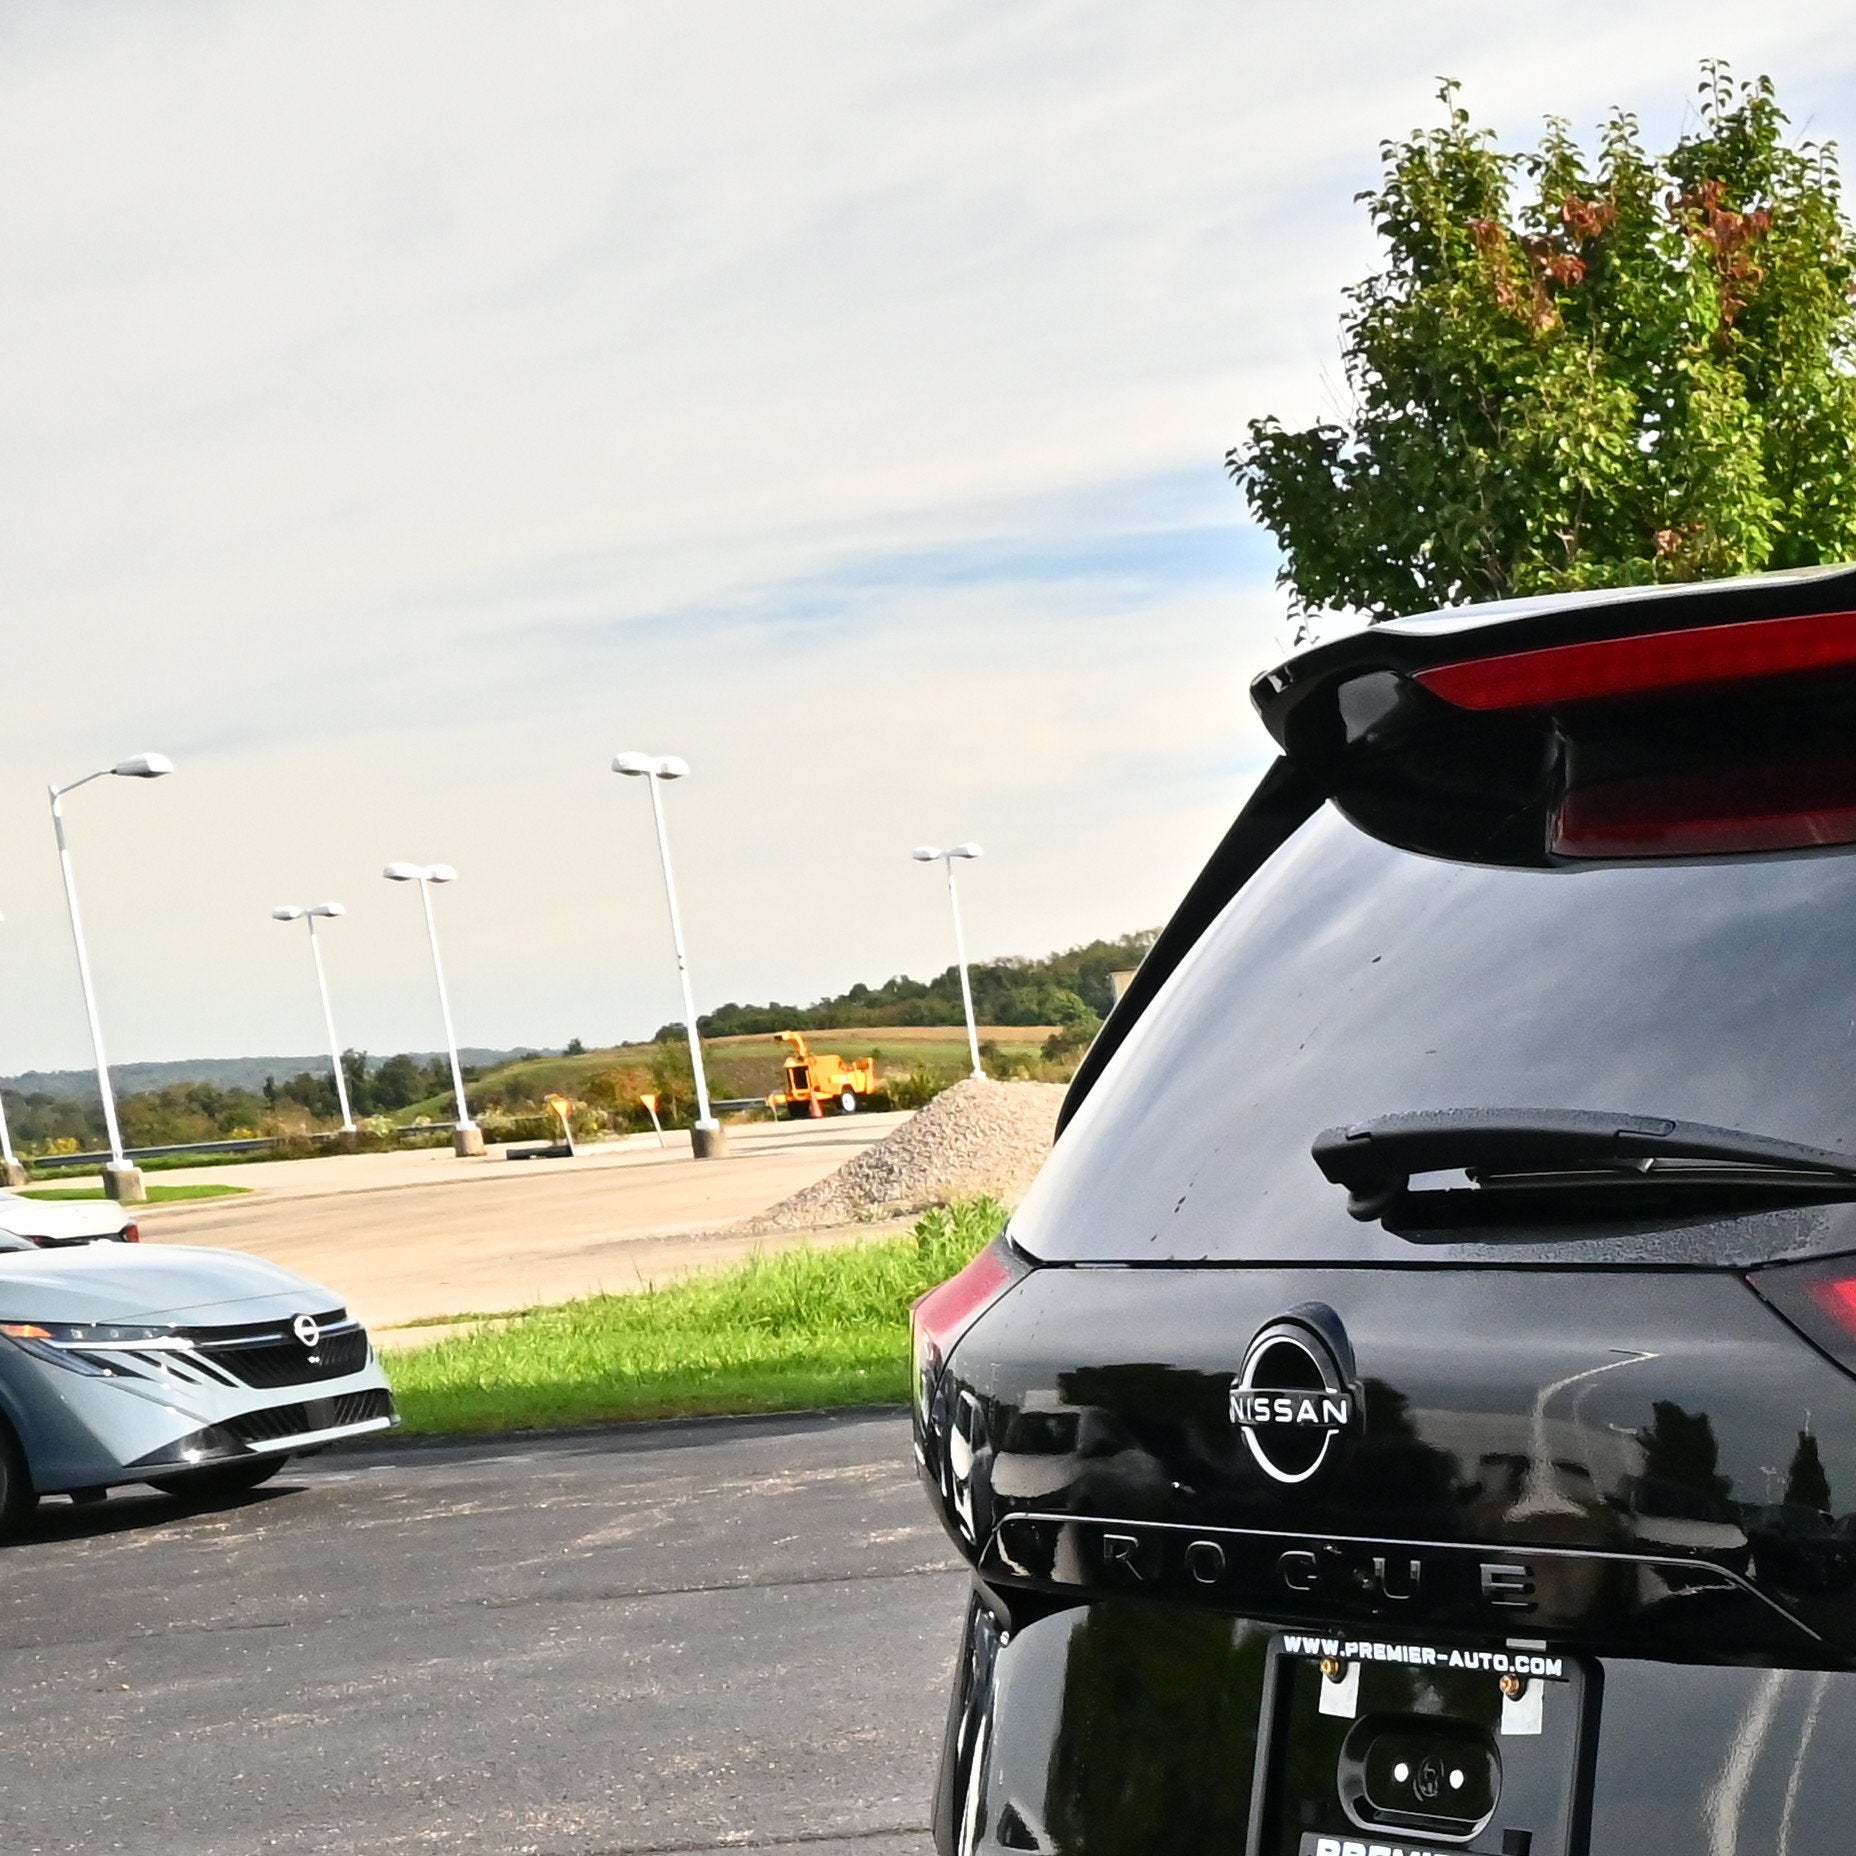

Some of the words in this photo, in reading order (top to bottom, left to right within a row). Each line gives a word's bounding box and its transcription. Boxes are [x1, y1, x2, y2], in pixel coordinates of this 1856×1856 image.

[1229, 1396, 1348, 1424] NISSAN
[1102, 1533, 1536, 1614] ROGUE
[1283, 1635, 1563, 1677] WWW.PREMIER-AUTO.COM
